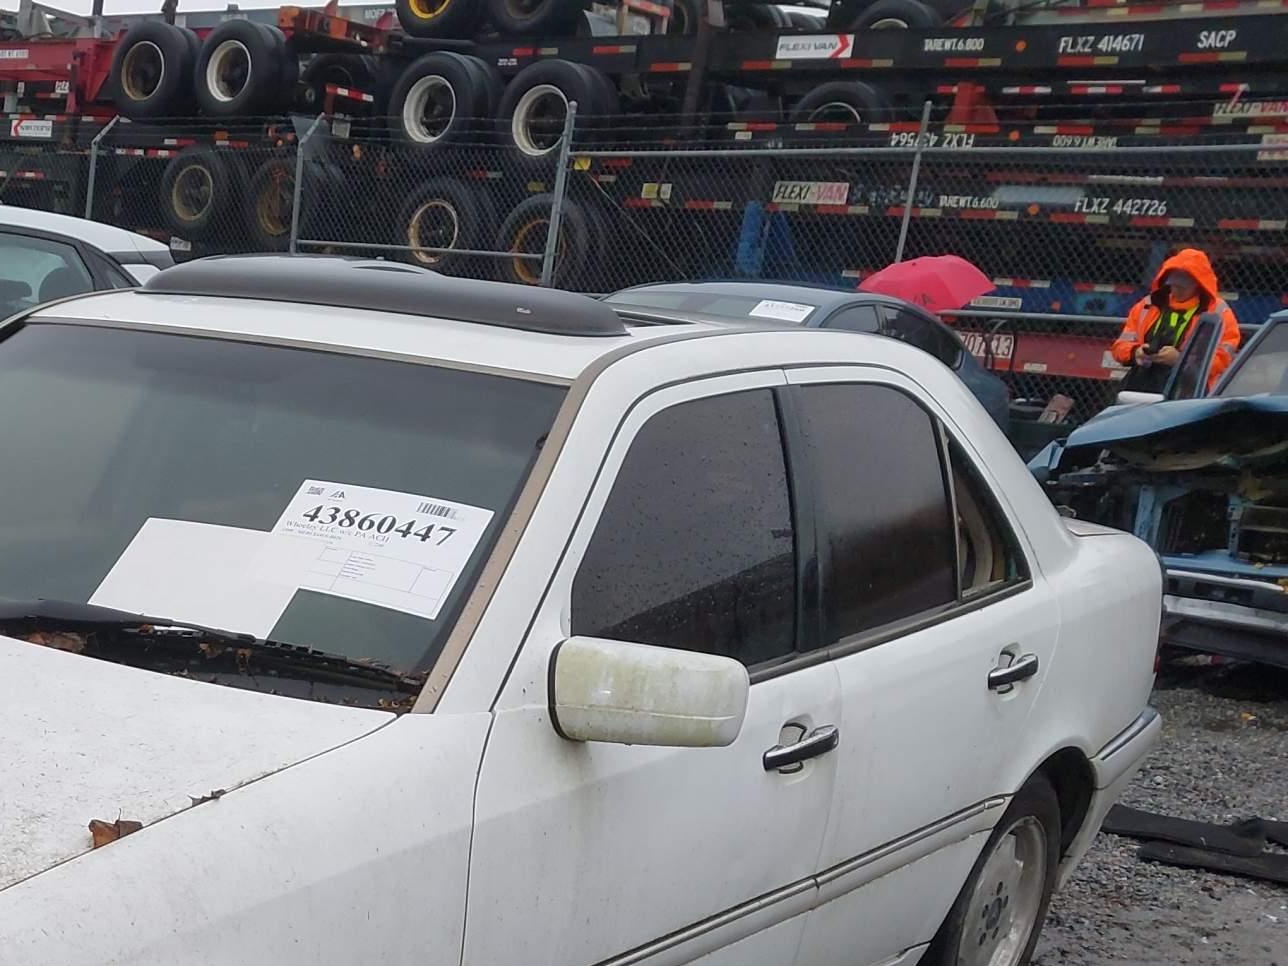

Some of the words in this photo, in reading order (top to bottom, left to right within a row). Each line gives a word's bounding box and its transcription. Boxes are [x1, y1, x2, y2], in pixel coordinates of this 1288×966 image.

[1058, 36, 1093, 53] FLXZ
[1097, 34, 1145, 52] 414671
[1197, 30, 1237, 49] SACP
[1074, 198, 1108, 213] FLXZ
[1112, 199, 1167, 216] 442726
[302, 504, 457, 546] 43860447
